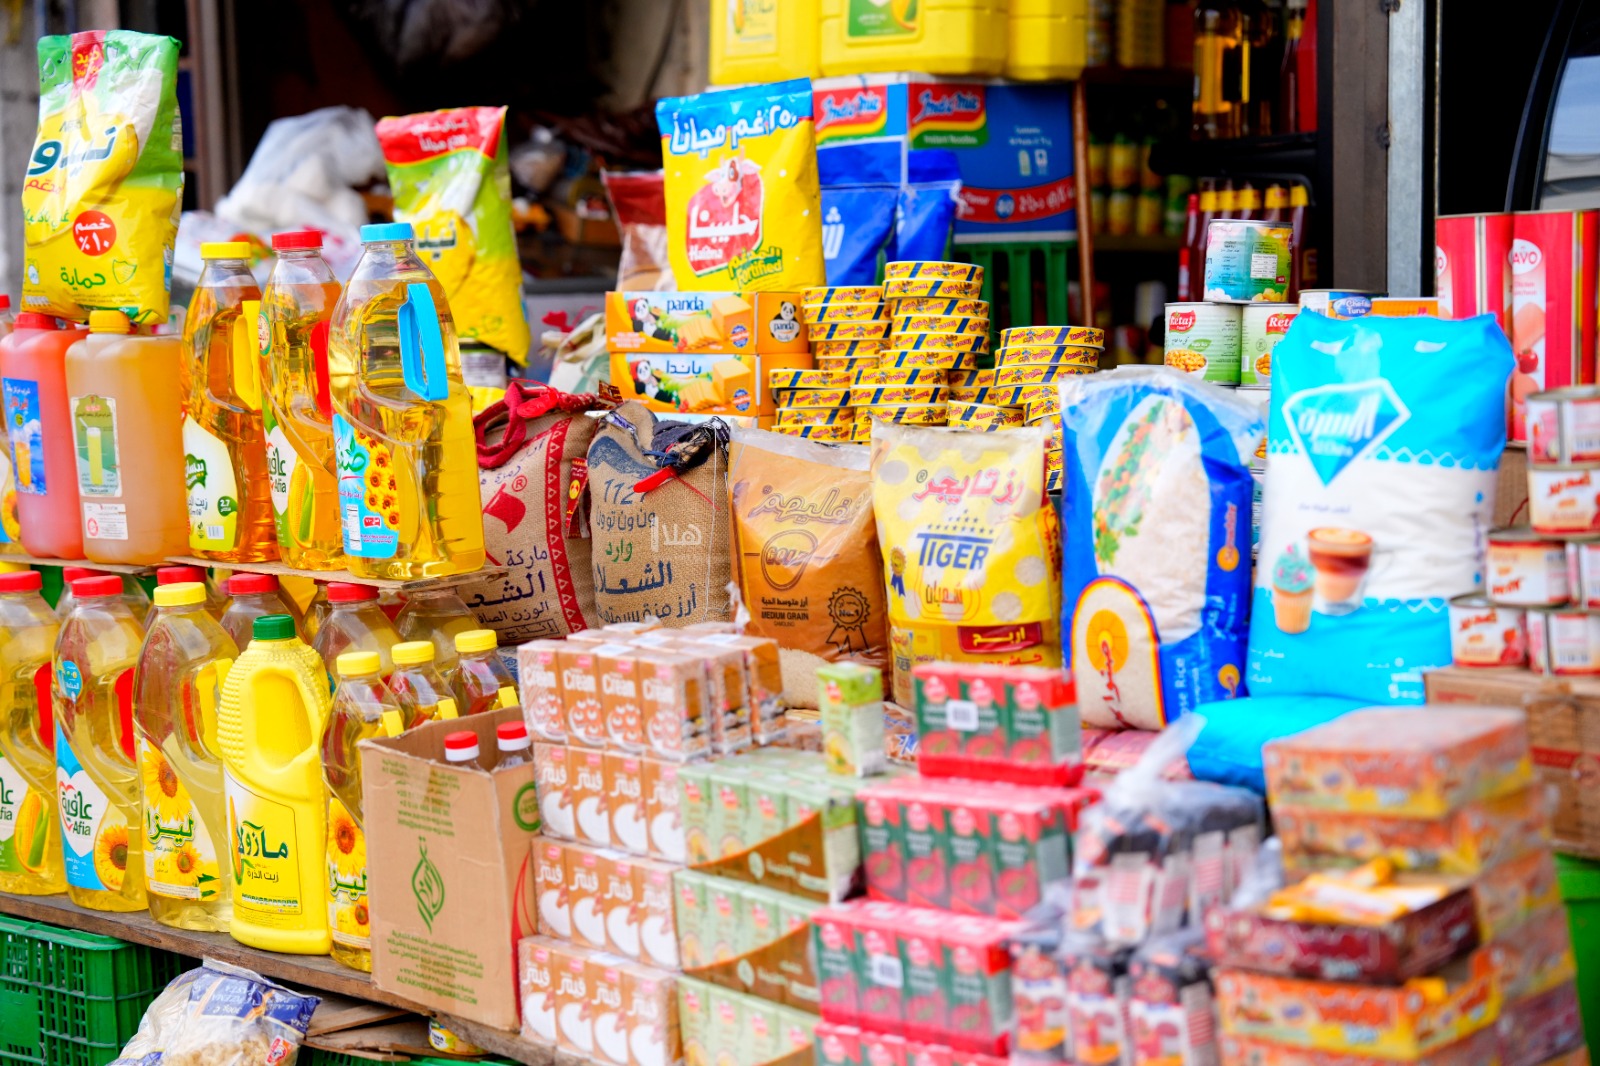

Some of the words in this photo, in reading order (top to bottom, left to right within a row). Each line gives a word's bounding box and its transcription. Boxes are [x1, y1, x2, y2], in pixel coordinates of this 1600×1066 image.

[75, 218, 111, 233] خصم
[60, 267, 106, 290] حماية
[736, 260, 783, 289] Fortified
[667, 296, 704, 314] panda
[773, 320, 795, 331] panda
[1269, 317, 1292, 328] Ret
[666, 360, 702, 378] باندا
[912, 468, 997, 505] تايجر
[506, 545, 548, 570] ماركة
[605, 538, 633, 563] وارد
[916, 533, 995, 571] TIGER
[677, 583, 697, 619] أرز
[478, 613, 508, 625] الصاف
[512, 602, 550, 623] الوزن
[762, 611, 786, 619] MEDIUM
[788, 612, 809, 620] GRAIN
[563, 669, 596, 692] Cream
[602, 673, 635, 698] Cream
[62, 790, 92, 821] عافية
[73, 821, 91, 836] Afia
[146, 810, 194, 843] ليزا
[247, 868, 263, 880] الذرة
[264, 872, 279, 883] زيت
